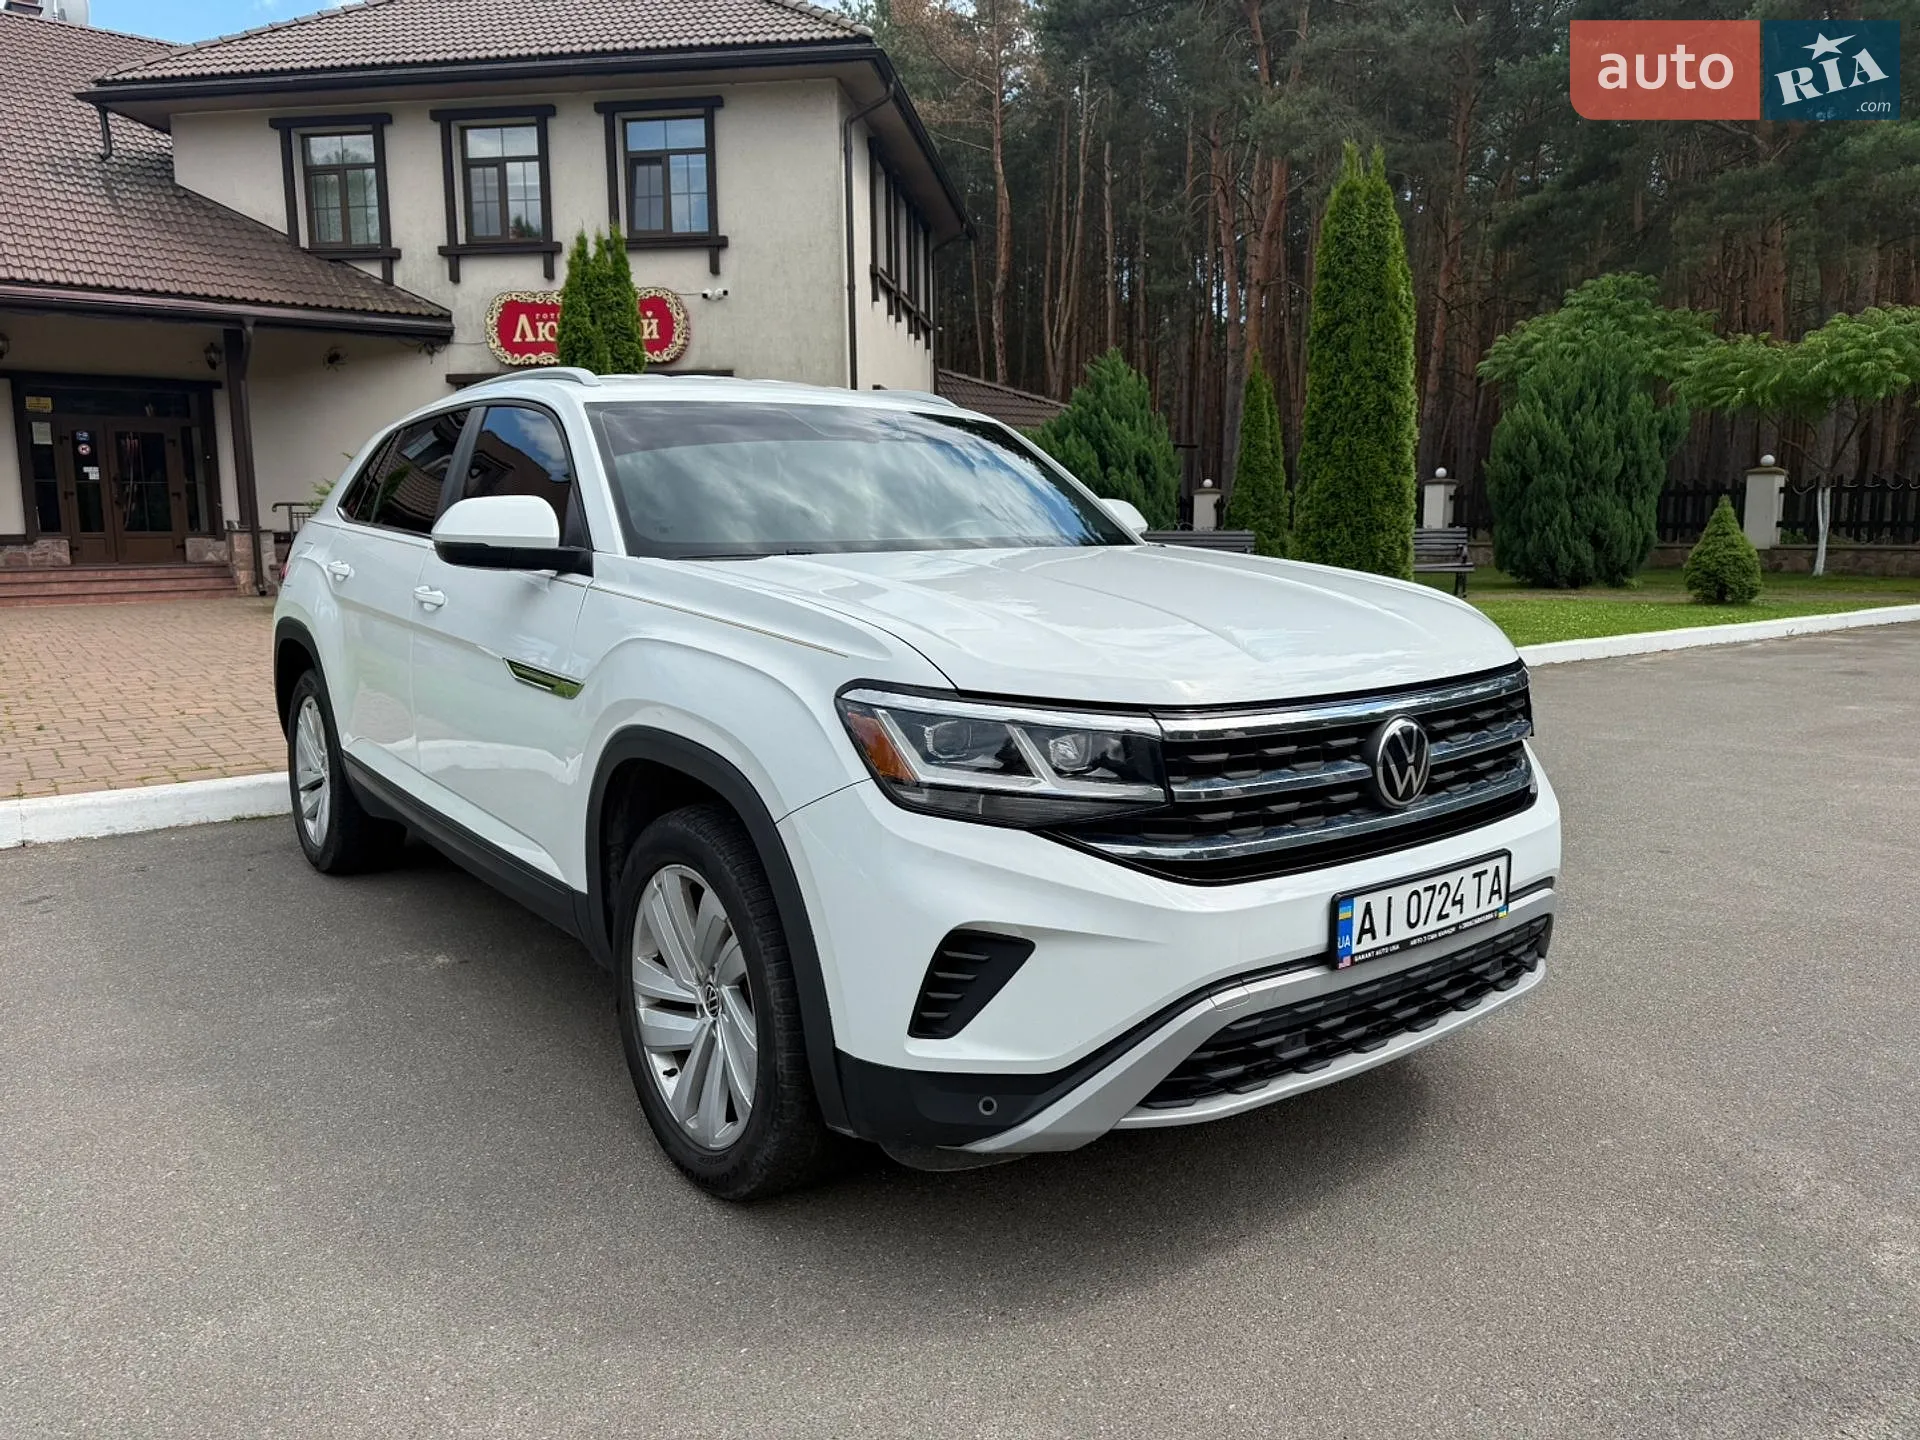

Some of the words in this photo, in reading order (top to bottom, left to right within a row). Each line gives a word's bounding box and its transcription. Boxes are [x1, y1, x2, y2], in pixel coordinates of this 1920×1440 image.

[1356, 896, 1393, 945] AI
[1406, 876, 1465, 929] 0724
[1472, 865, 1503, 909] TA
[1337, 934, 1351, 949] UA
